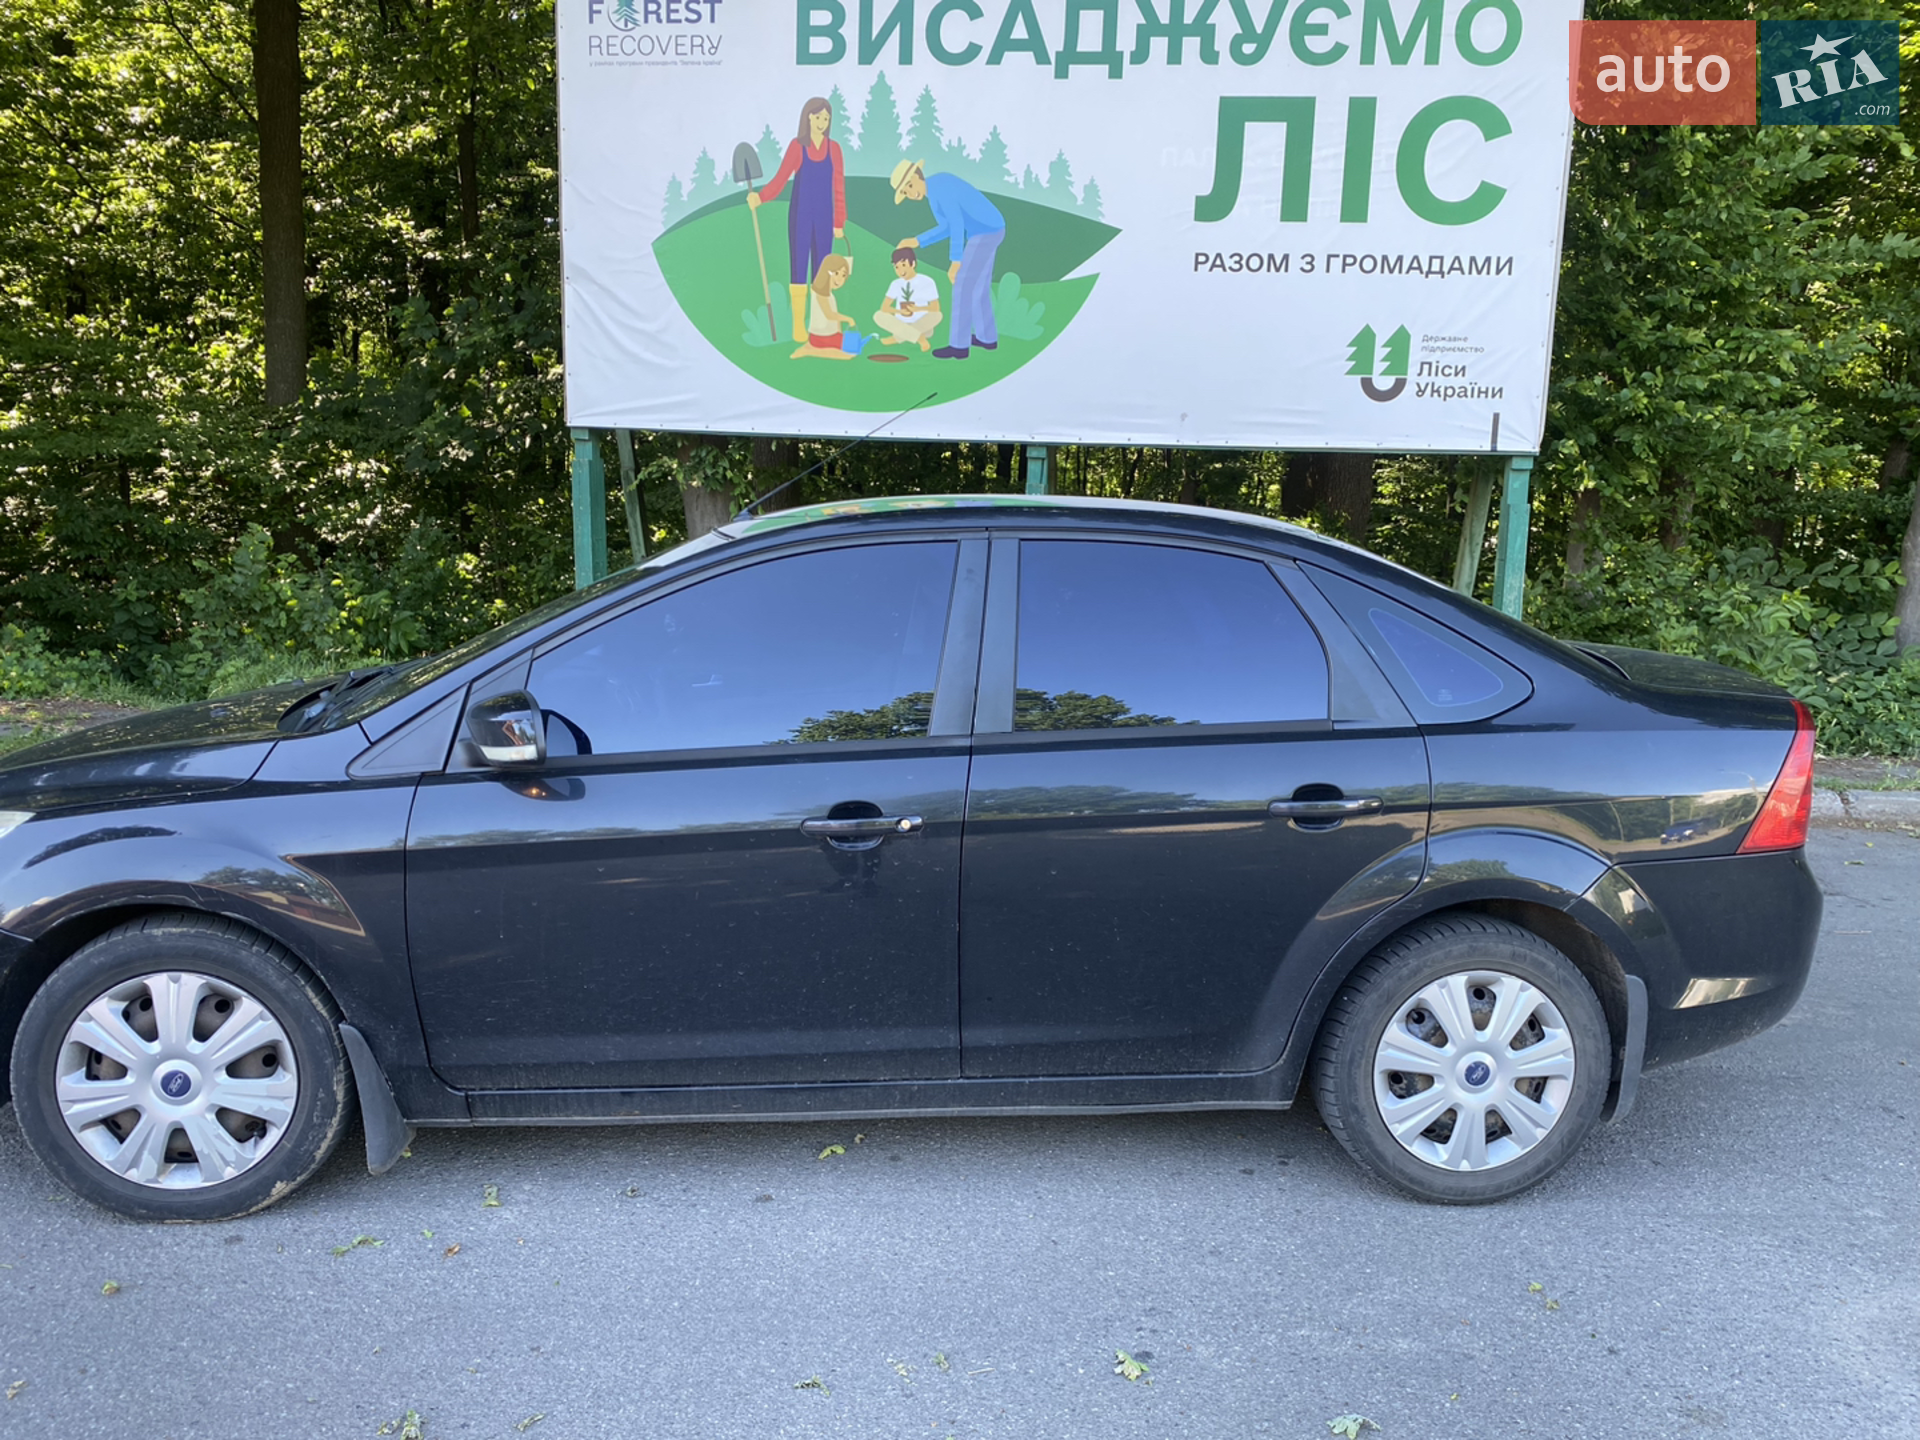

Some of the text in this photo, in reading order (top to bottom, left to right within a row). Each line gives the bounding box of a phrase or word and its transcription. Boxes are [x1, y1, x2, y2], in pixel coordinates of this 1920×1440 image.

[588, 35, 723, 56] RECOVERY
[796, 0, 1523, 79] ВИСАДЖУЄМО
[1194, 94, 1513, 226] ЛІС
[1193, 252, 1290, 273] РАЗОМ
[1325, 254, 1514, 279] ГРОМАДАМИ
[1421, 334, 1468, 343] Державне
[1420, 345, 1485, 354] підприємство
[1416, 360, 1467, 378] Ліси
[1415, 381, 1504, 402] України
